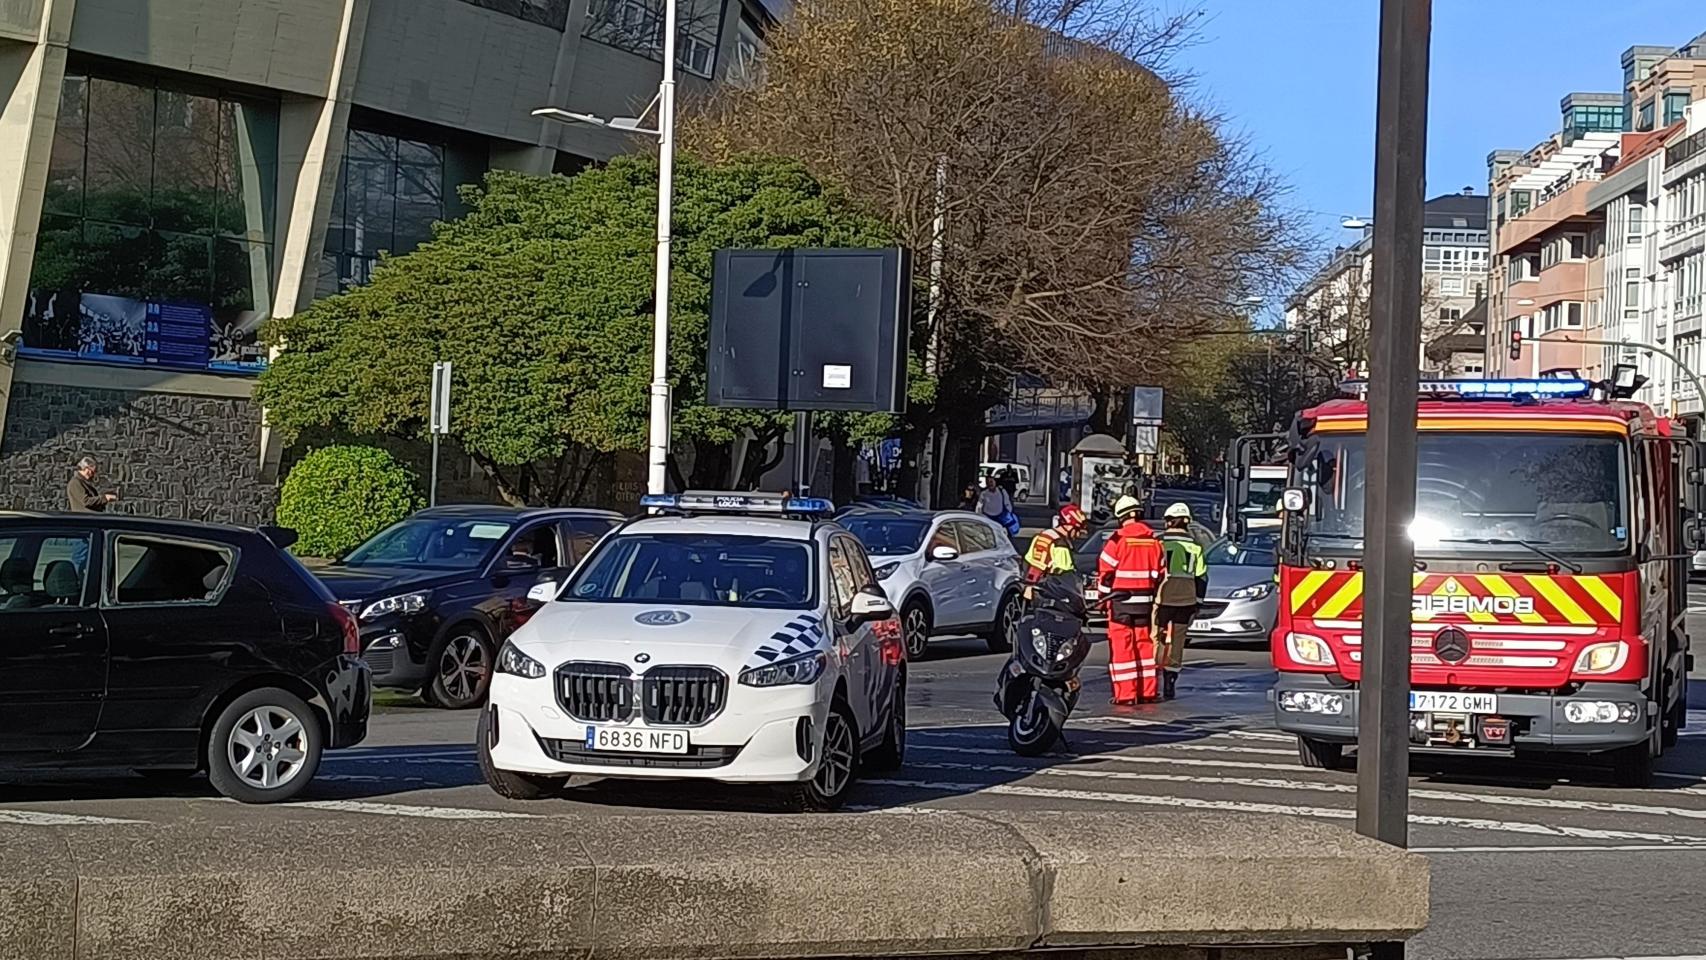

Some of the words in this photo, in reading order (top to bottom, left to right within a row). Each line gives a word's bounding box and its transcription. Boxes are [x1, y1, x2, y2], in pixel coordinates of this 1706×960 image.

[619, 481, 639, 491] LUIS
[1418, 695, 1457, 710] 7172
[1462, 696, 1493, 711] GMH
[599, 730, 643, 748] 6836
[649, 732, 684, 750] NFD
